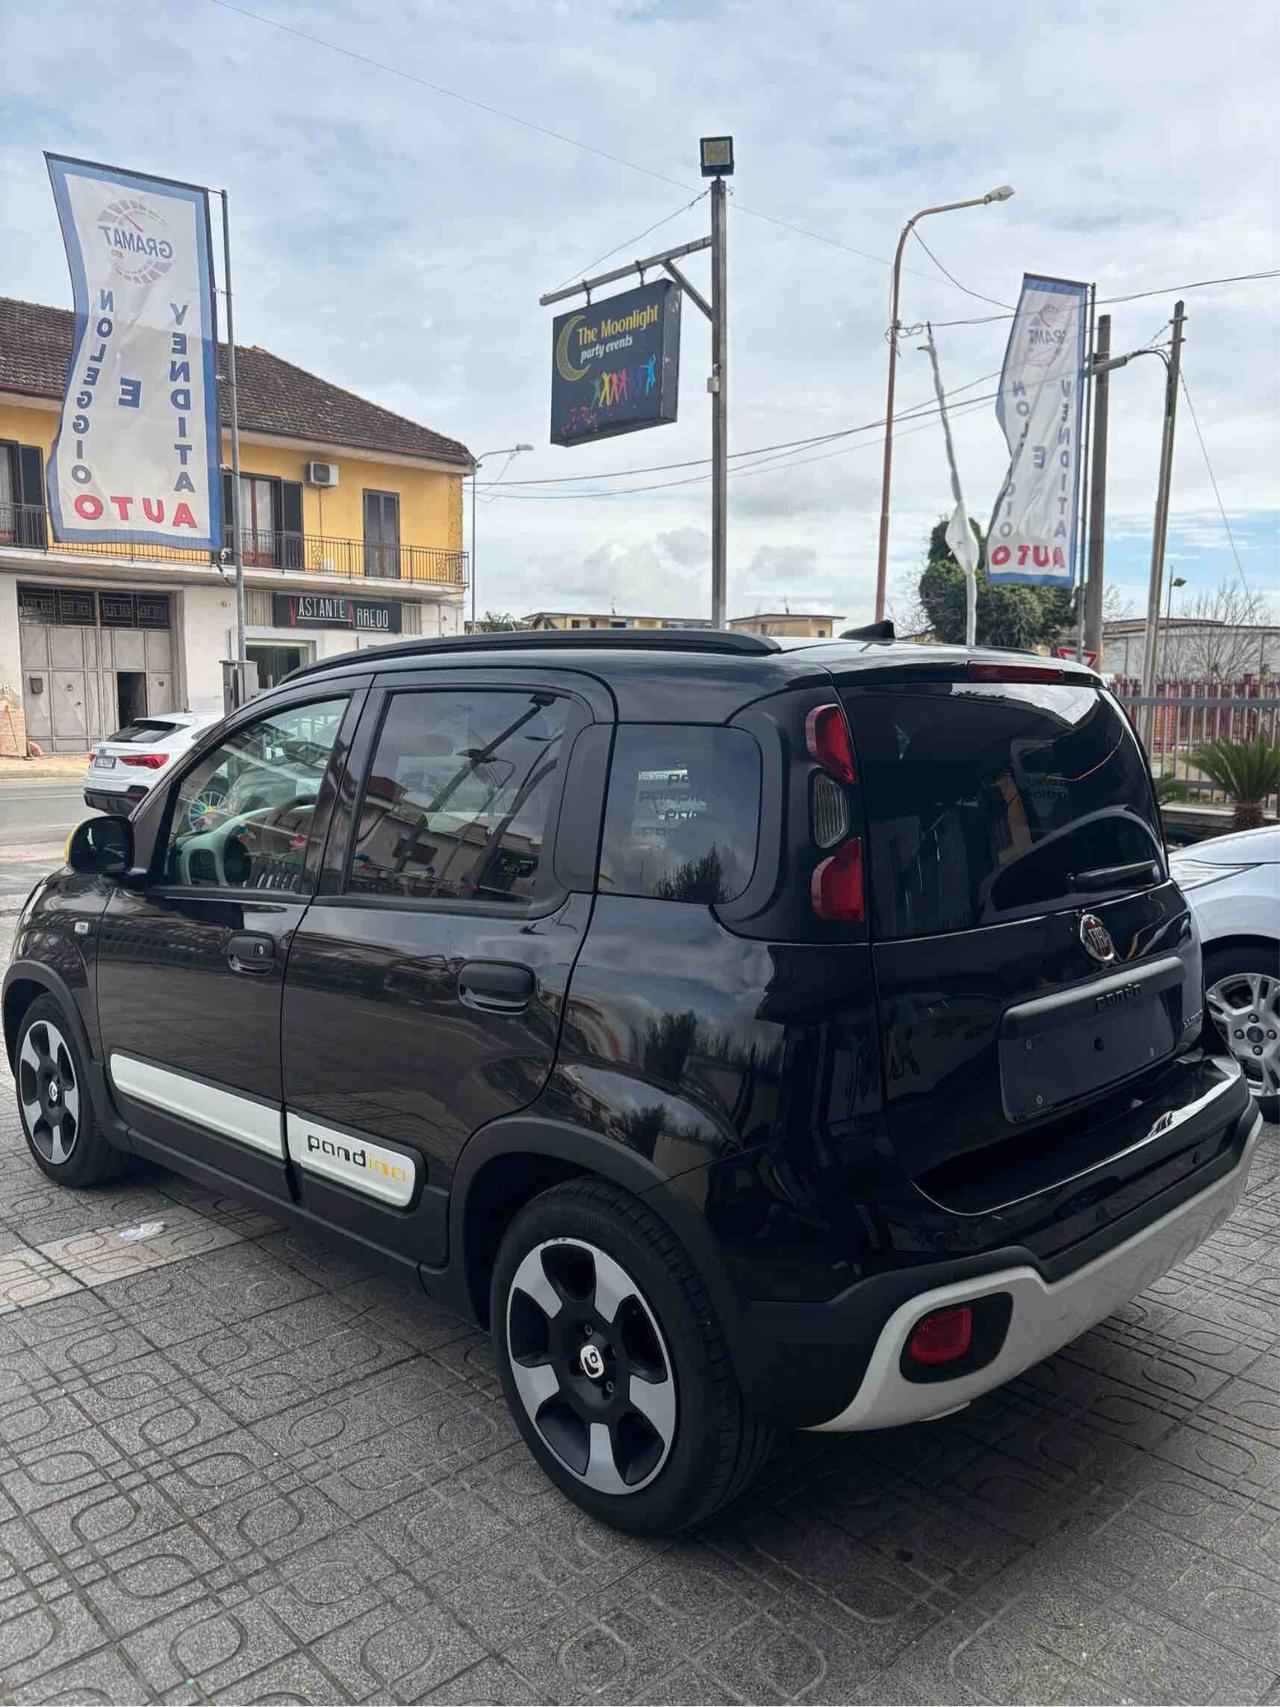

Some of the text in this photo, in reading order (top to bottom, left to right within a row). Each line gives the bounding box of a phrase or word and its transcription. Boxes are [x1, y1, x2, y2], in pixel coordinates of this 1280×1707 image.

[576, 305, 660, 346] The Moonlight
[580, 335, 633, 364] party events
[289, 596, 390, 628] VASTANTE ARREDO
